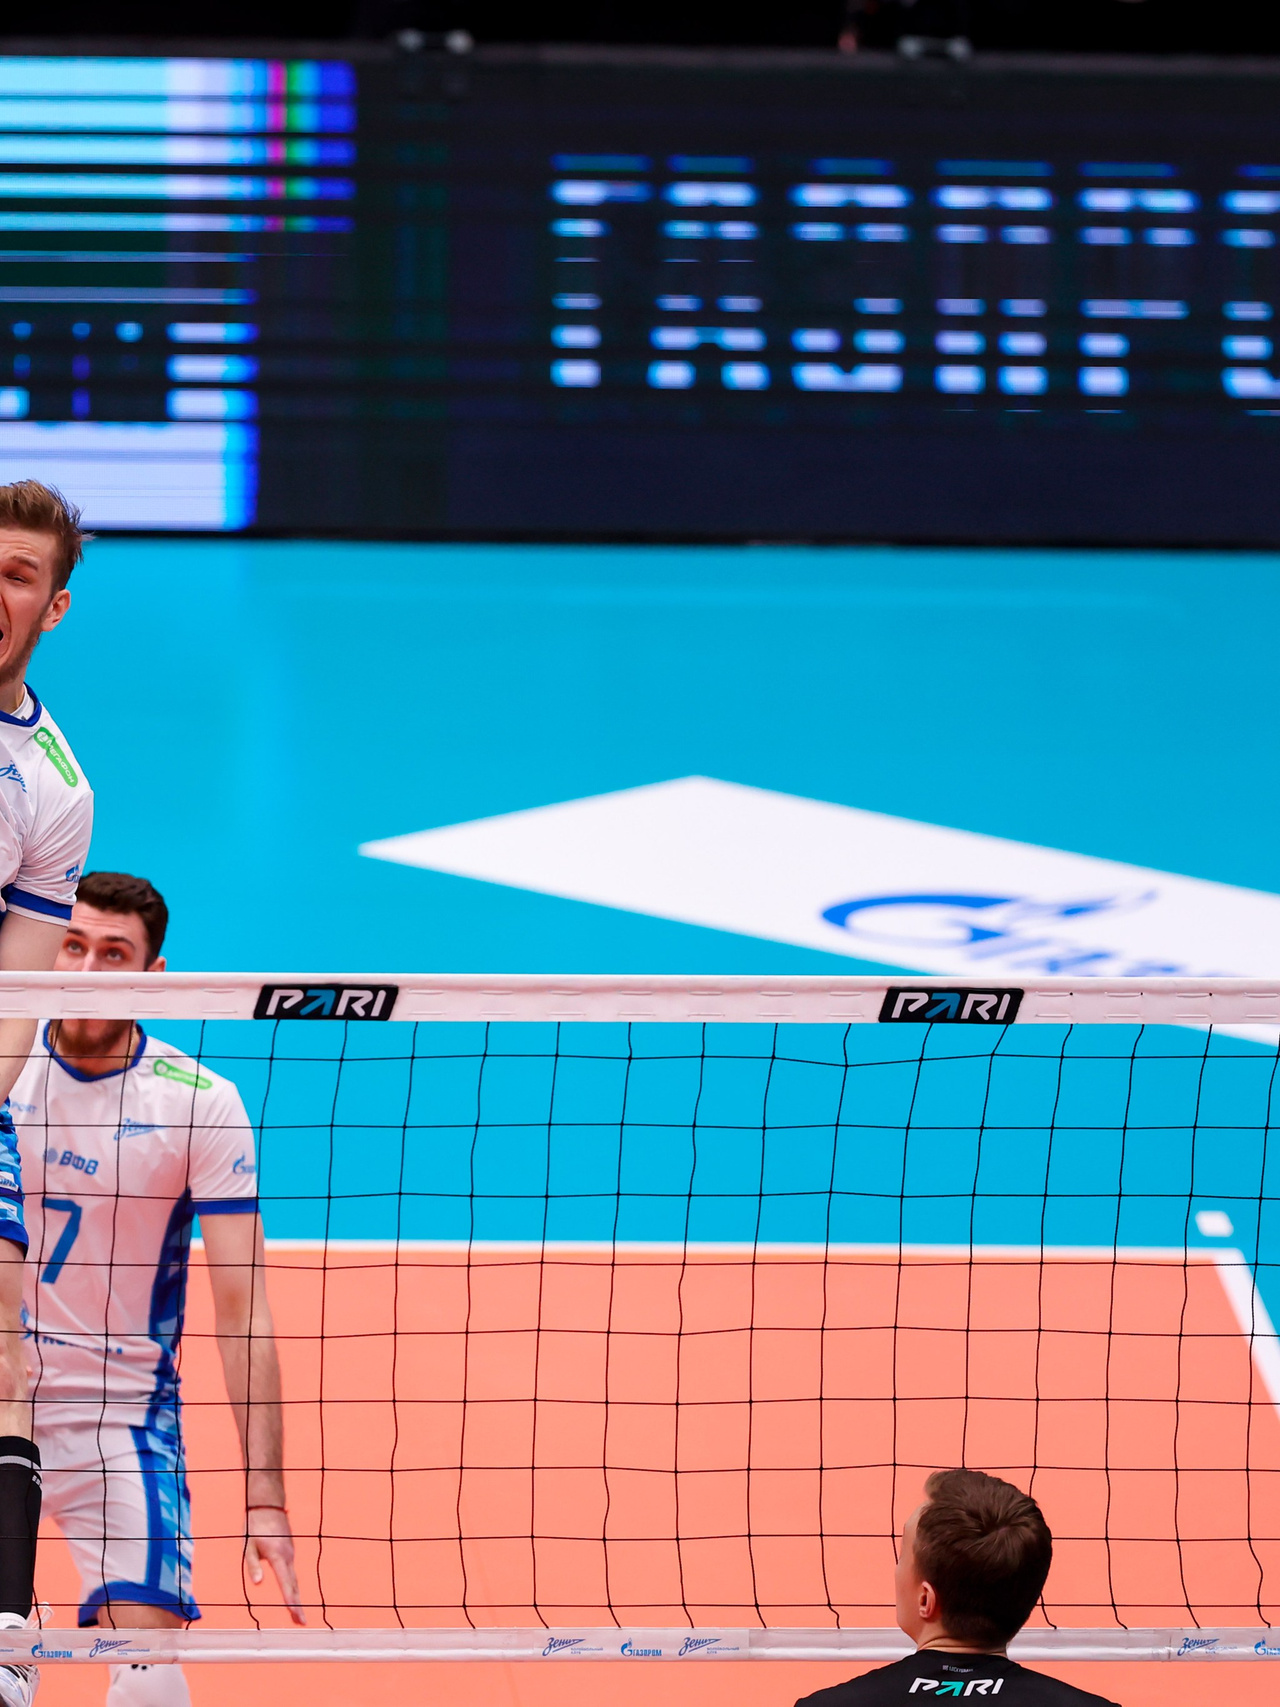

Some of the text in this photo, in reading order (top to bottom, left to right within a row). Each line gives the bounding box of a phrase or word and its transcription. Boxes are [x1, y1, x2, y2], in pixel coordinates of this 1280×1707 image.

[265, 989, 387, 1018] PARI
[891, 992, 1011, 1021] PARI
[58, 1151, 99, 1176] ВФВ
[41, 1197, 82, 1285] 7
[908, 1677, 1005, 1697] PARI
